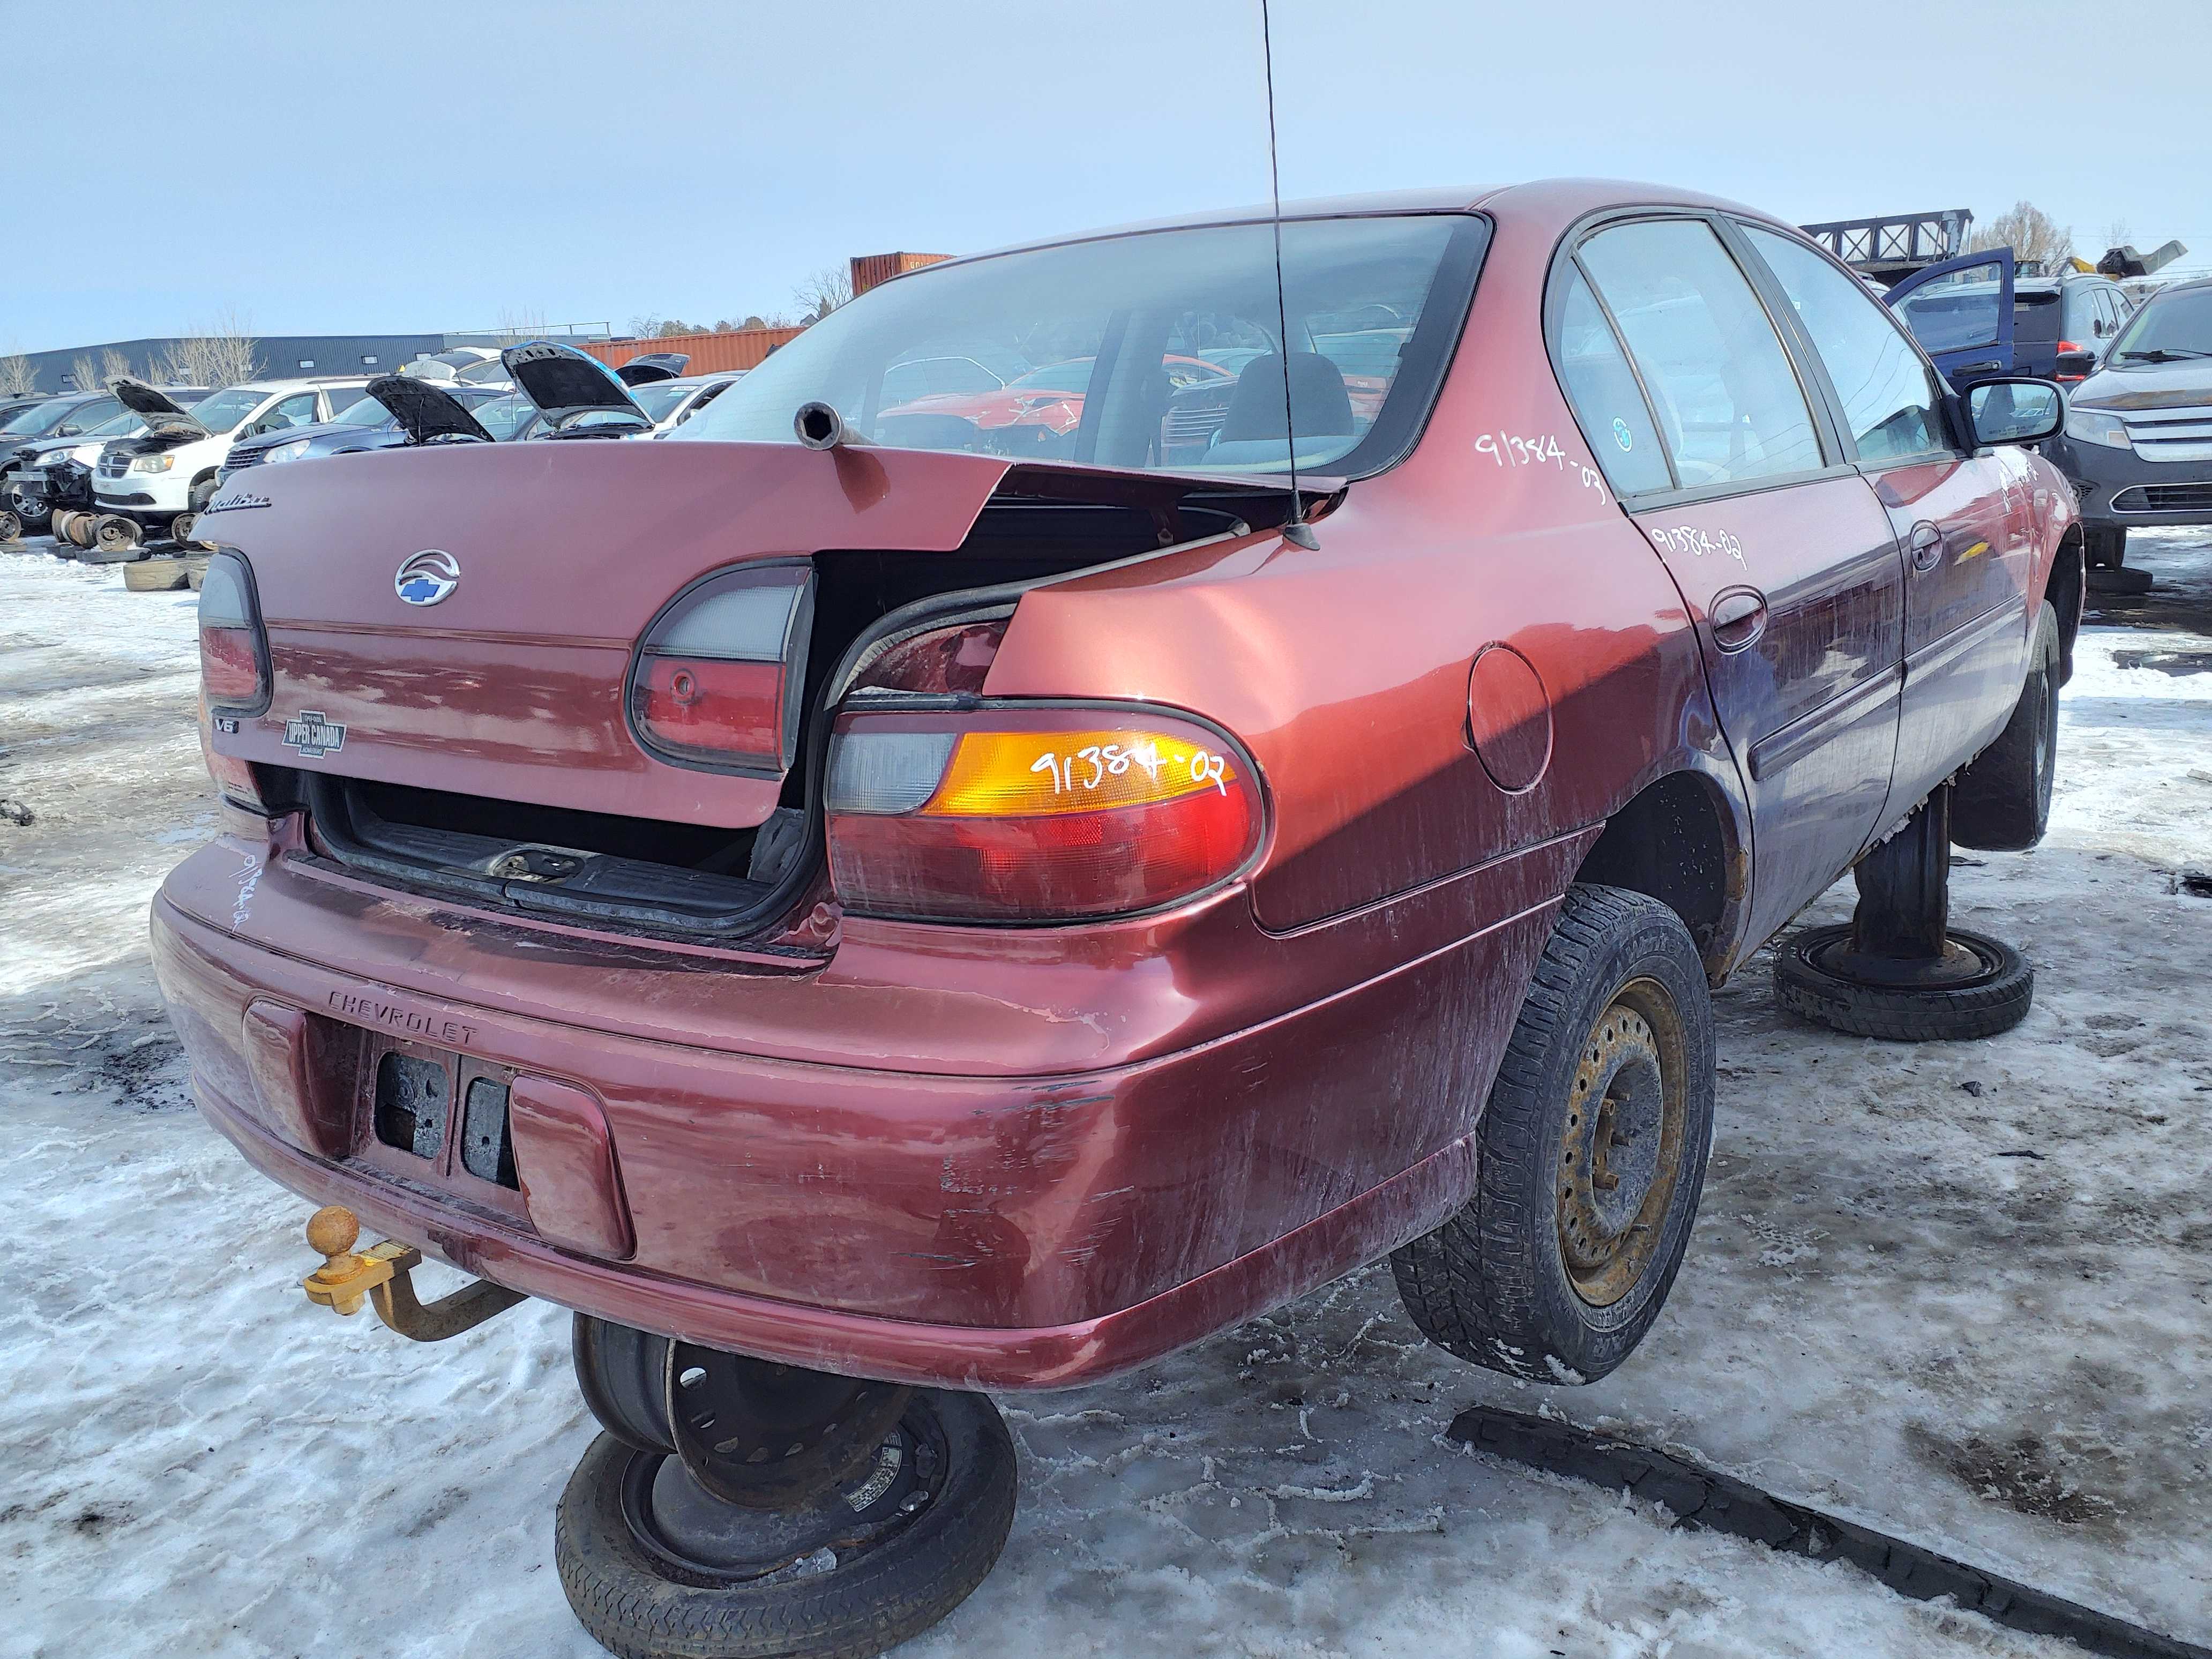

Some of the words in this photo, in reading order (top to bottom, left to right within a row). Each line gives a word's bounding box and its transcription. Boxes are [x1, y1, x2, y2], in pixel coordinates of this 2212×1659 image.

[214, 719, 239, 734] V6
[288, 722, 310, 745] UPPER
[311, 724, 340, 748] CANADA
[328, 991, 478, 1045] CHEVROLET
